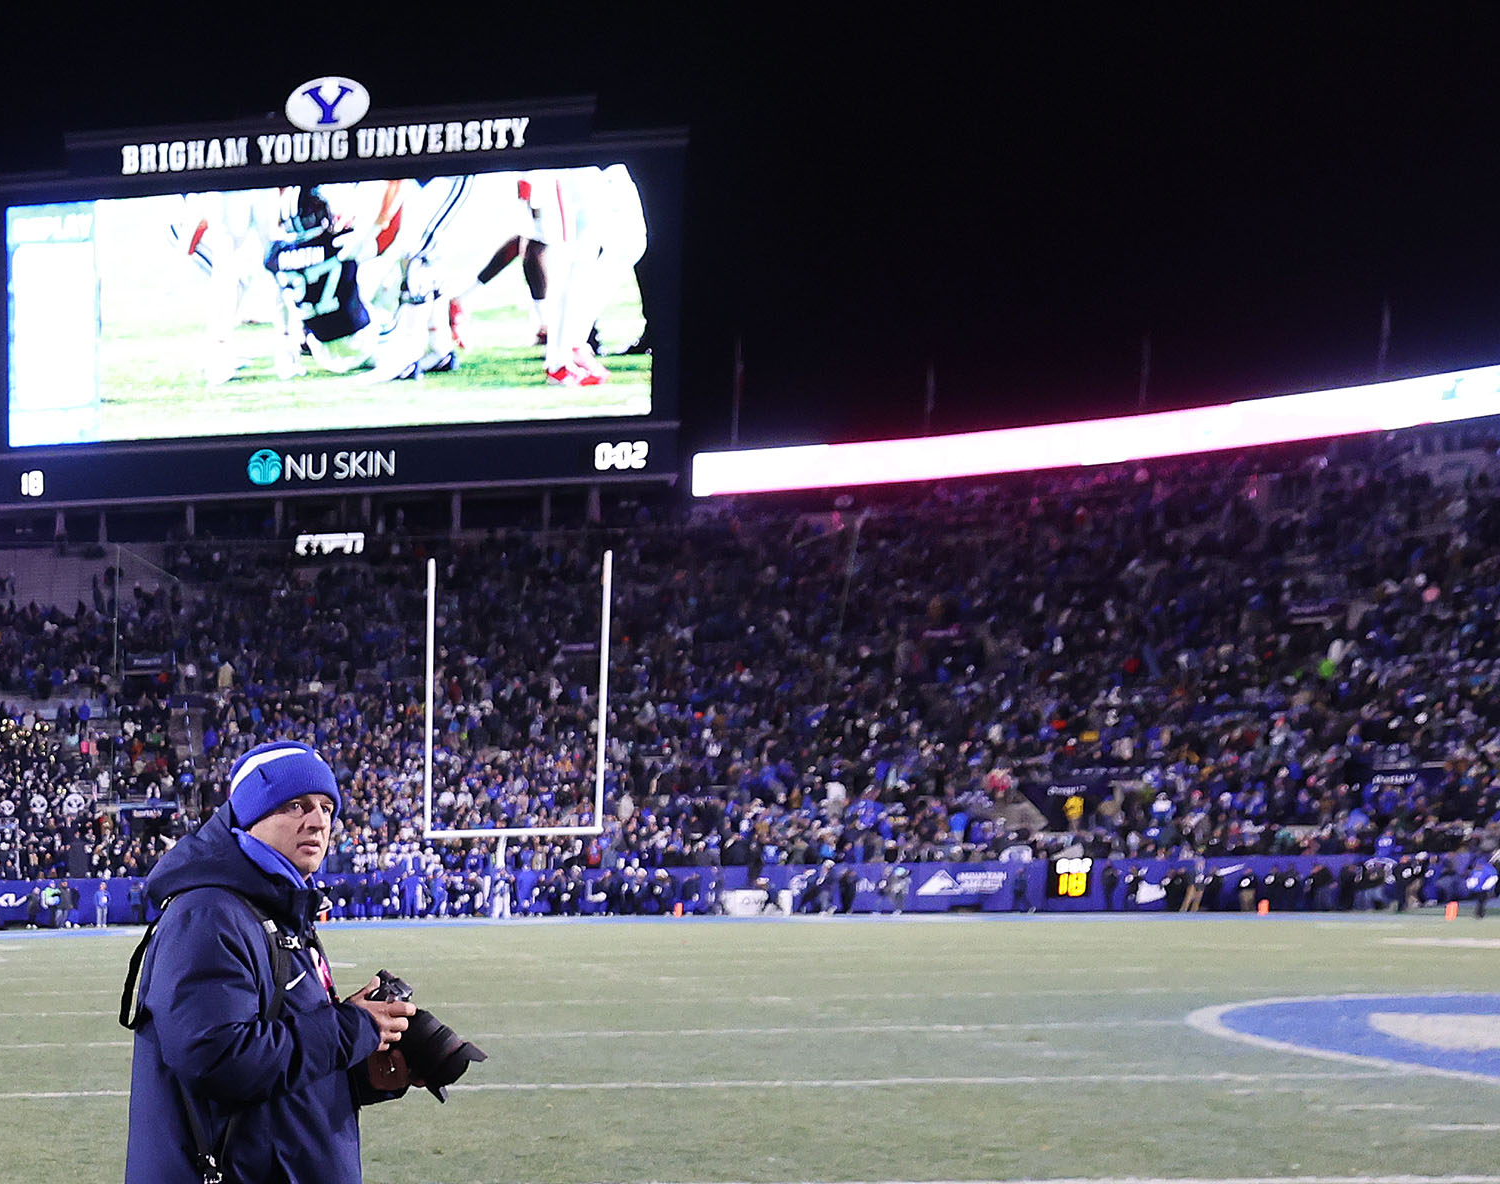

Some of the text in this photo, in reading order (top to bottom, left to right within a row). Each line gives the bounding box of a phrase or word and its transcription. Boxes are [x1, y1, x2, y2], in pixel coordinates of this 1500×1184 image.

[302, 85, 353, 124] Y
[121, 117, 530, 175] BRIGHAM YOUNG UNIVERSITY
[284, 450, 396, 481] NU SKIN
